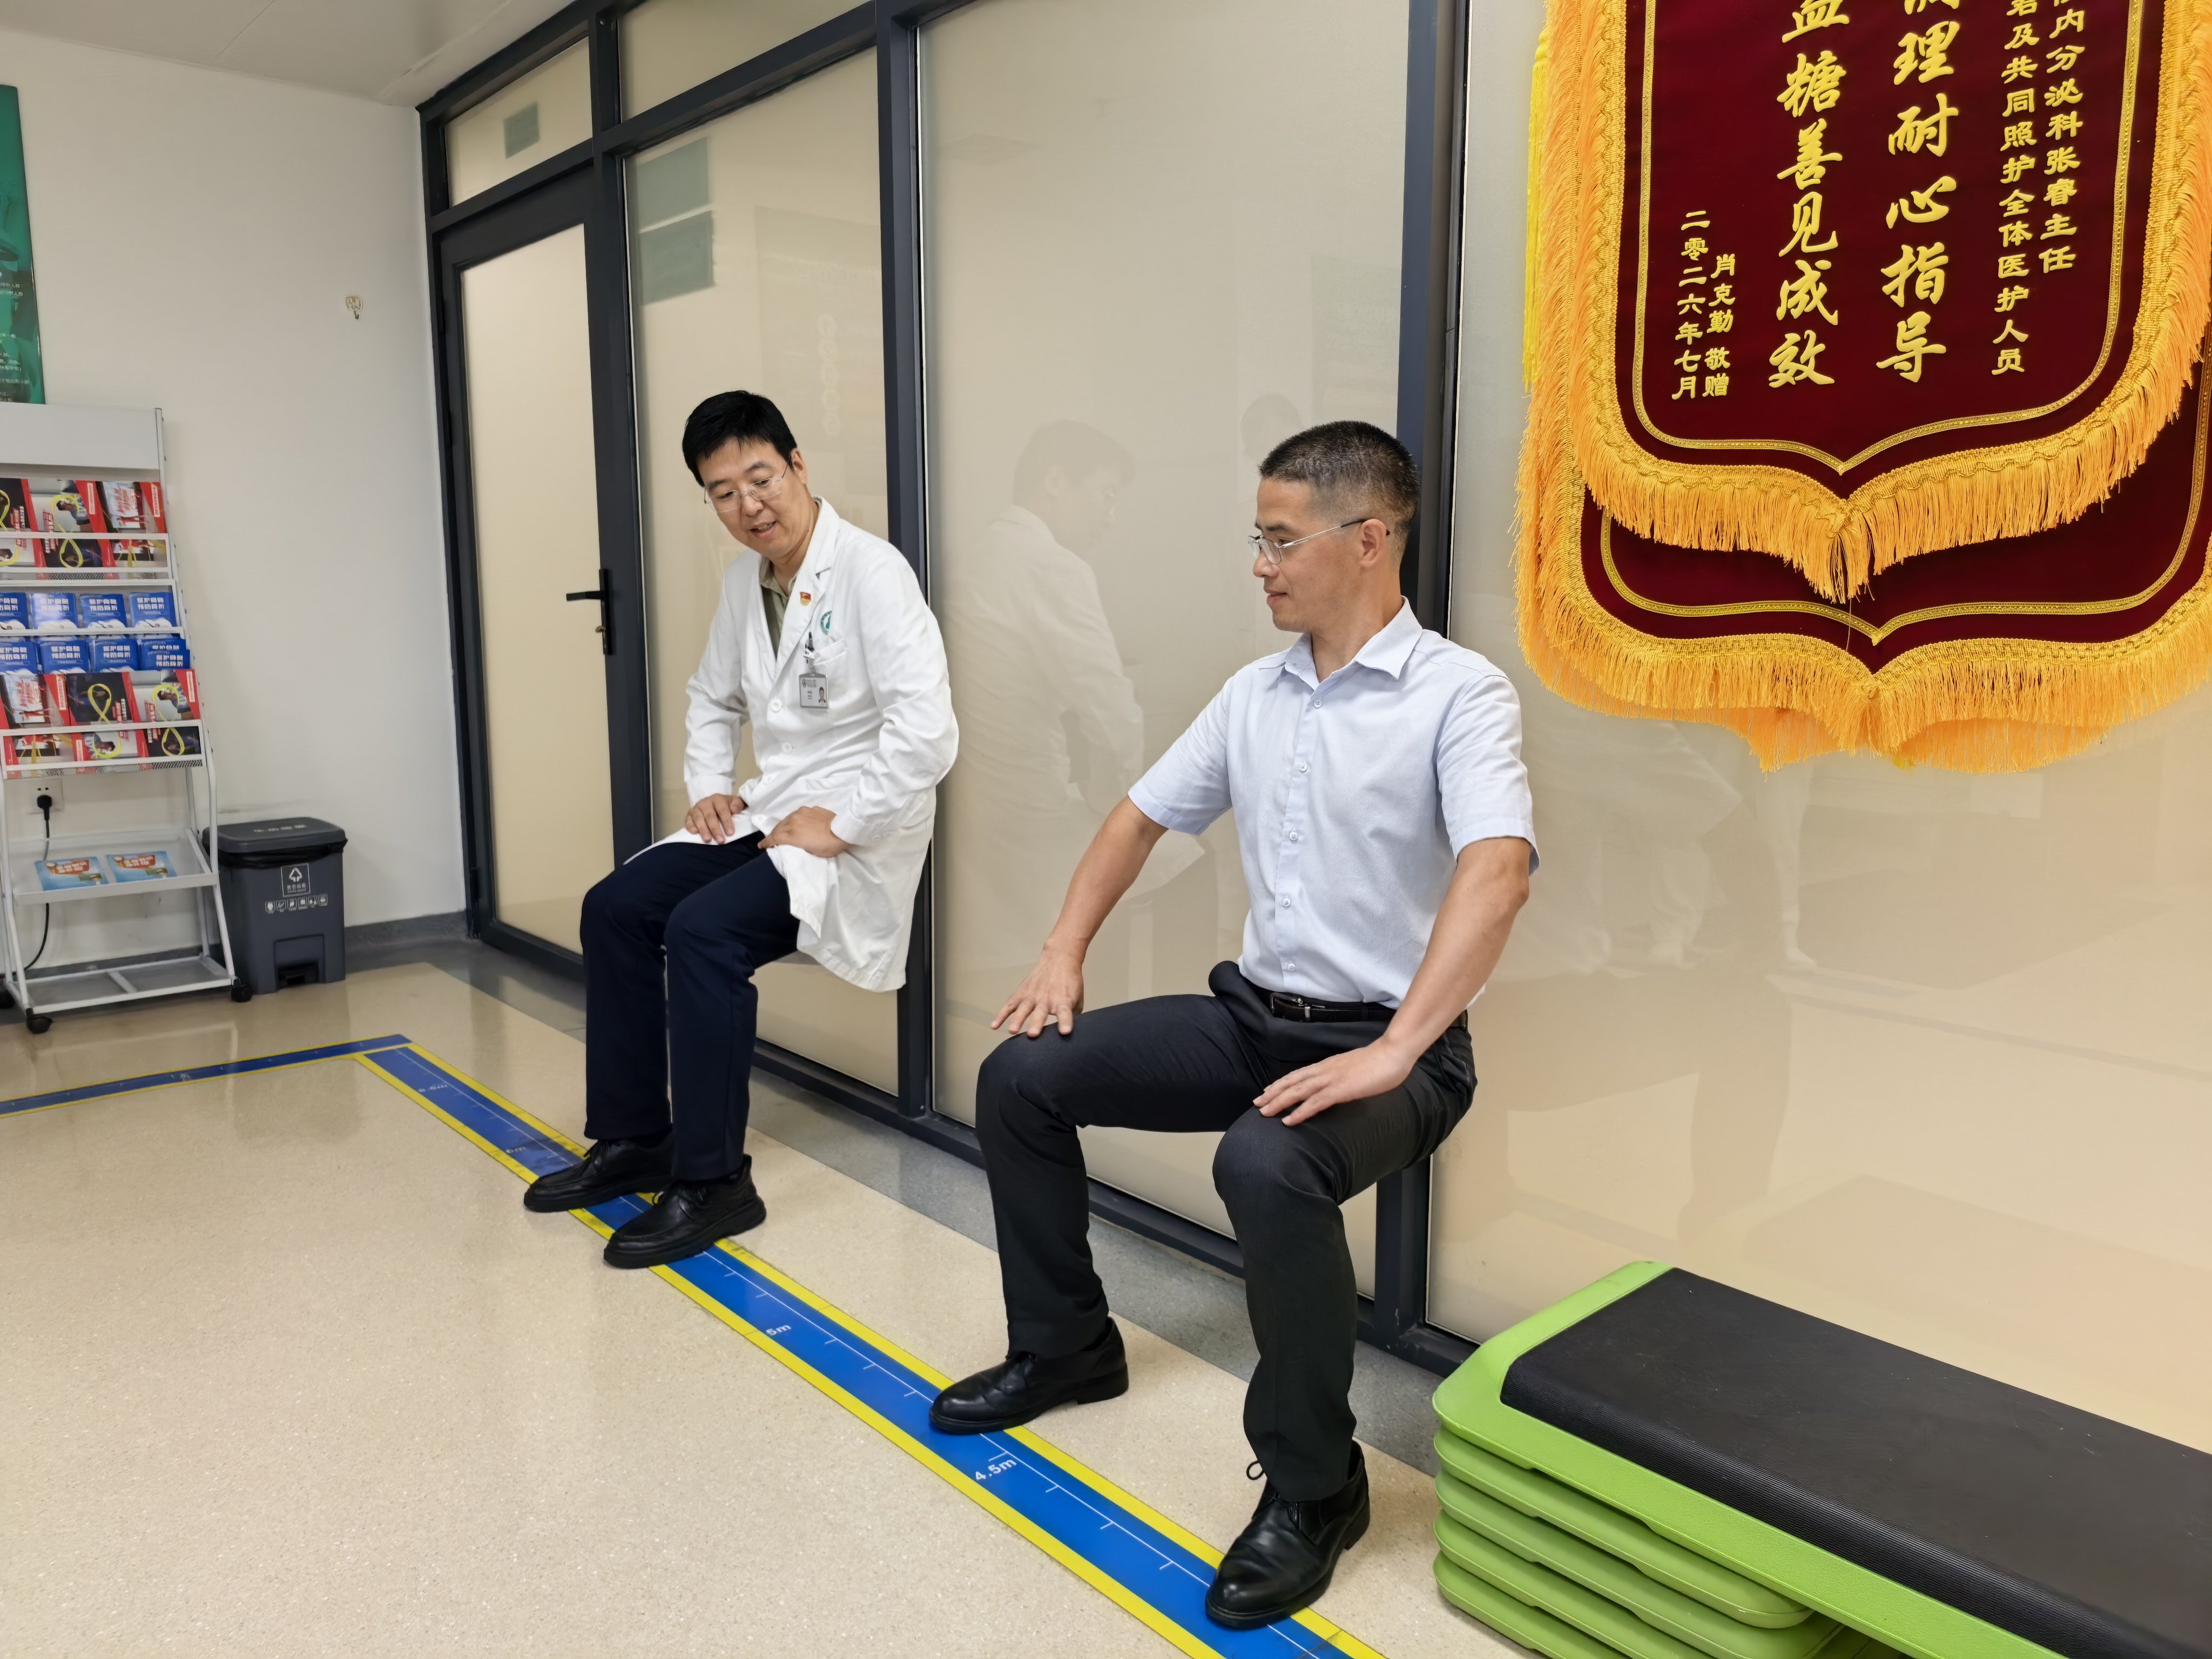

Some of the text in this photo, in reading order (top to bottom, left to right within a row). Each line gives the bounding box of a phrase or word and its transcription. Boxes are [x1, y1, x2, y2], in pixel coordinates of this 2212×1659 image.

[1876, 0, 1960, 383] 理耐心指导
[2038, 0, 2085, 274] 内分泌科张睿主任
[1672, 211, 1710, 400] 二零二六年七月
[1702, 254, 1736, 397] 肖克勤 敬赠
[766, 1323, 792, 1337] 5m
[974, 1457, 1017, 1482] 4.5m
